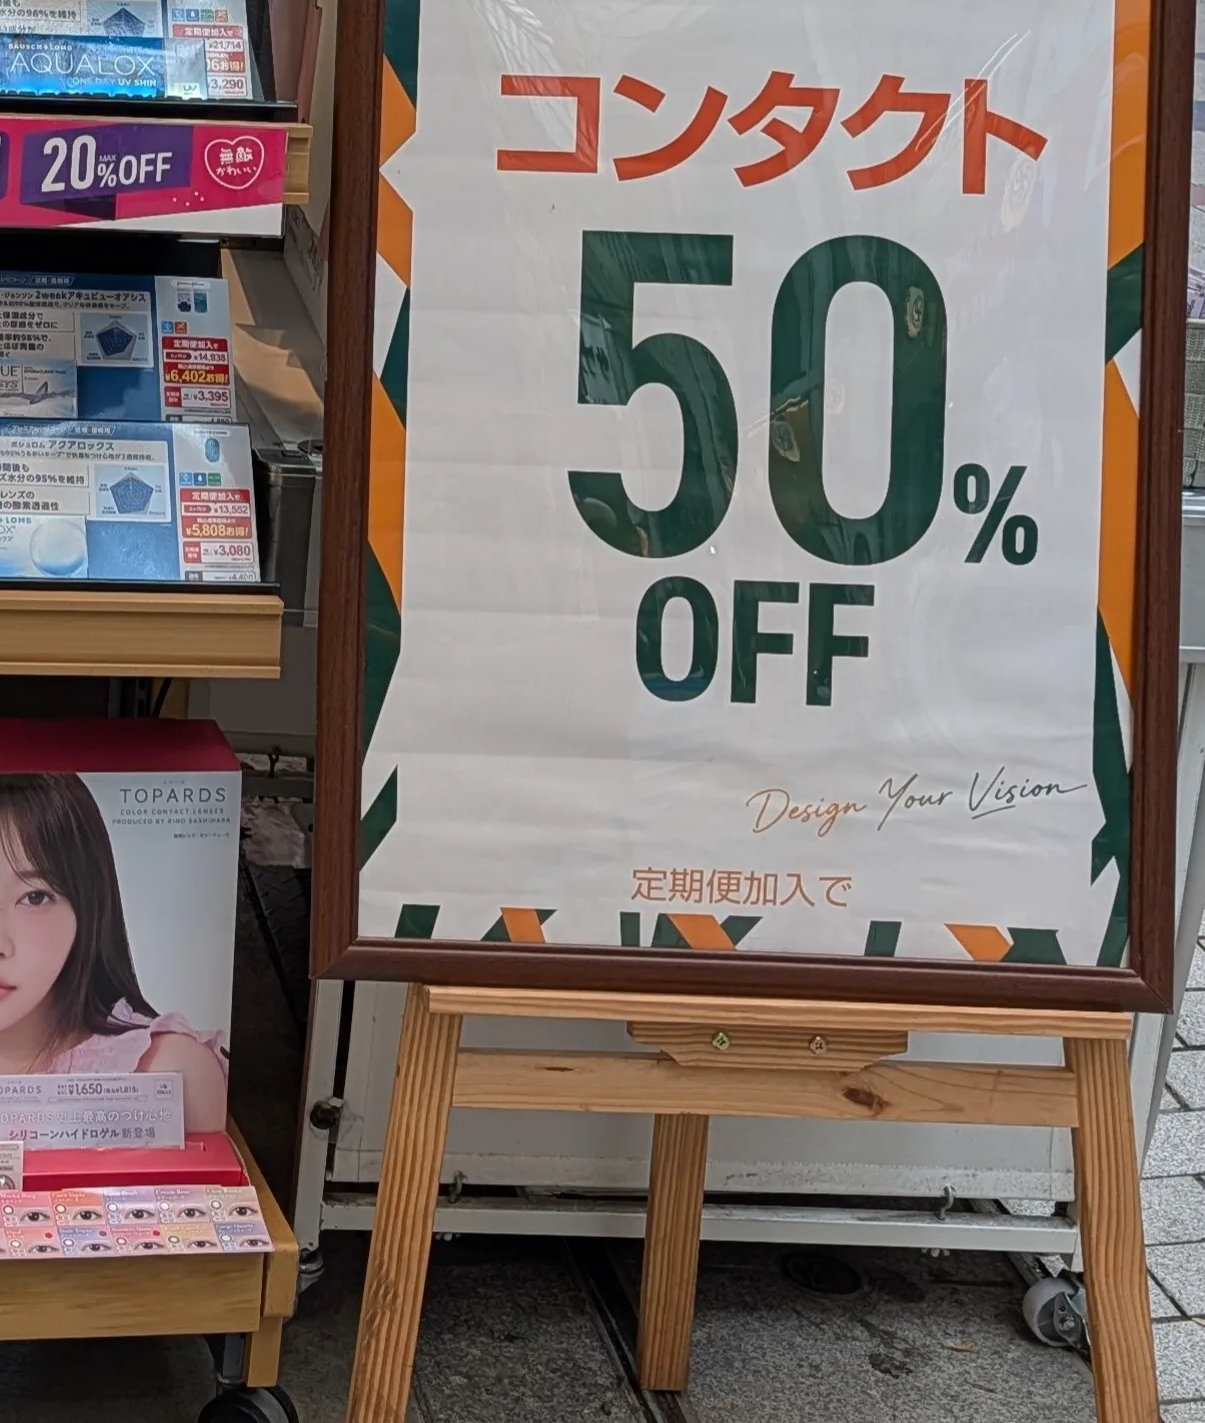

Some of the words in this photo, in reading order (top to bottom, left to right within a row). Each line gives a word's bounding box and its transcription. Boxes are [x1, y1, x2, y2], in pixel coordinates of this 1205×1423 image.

[8, 52, 156, 76] AQUALOX
[496, 71, 1049, 196] コンタクト
[48, 440, 114, 451] アクアロックス
[635, 574, 876, 708] OFF
[120, 788, 226, 804] TOPARDS
[745, 788, 868, 838] Design
[877, 773, 953, 832] Your
[969, 766, 1088, 820] Vision
[630, 867, 853, 908] 定期便加入で
[8, 1128, 120, 1141] シリコーンハイドロゲル
